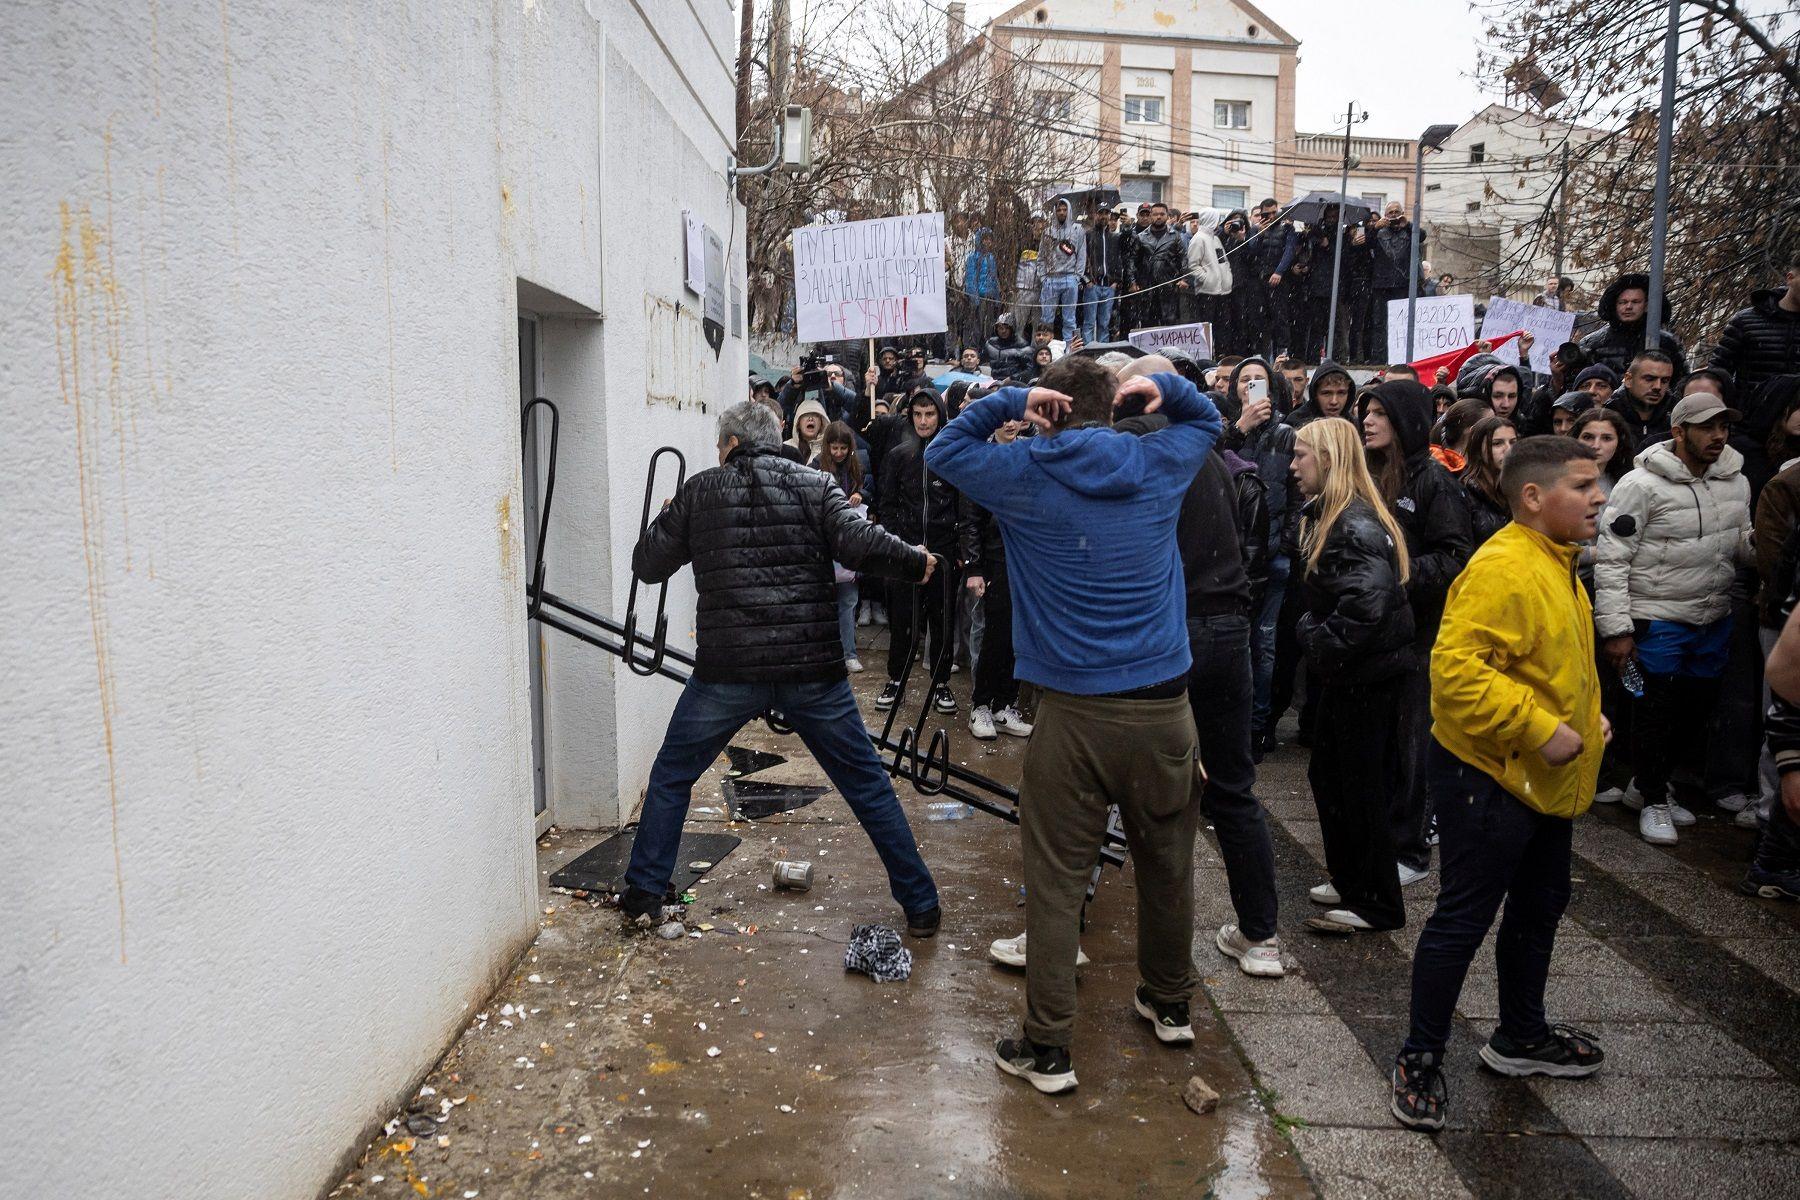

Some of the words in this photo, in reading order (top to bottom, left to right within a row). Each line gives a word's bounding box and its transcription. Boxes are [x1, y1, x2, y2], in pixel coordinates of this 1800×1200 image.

[863, 222, 887, 260] ШТО
[893, 216, 940, 257] ИМАА
[801, 265, 854, 305] ЗАДАЧА
[855, 263, 875, 301] ДА
[878, 259, 895, 298] НЕ
[896, 257, 939, 295] ЧУВААТ
[829, 300, 856, 340] НЕ
[1149, 328, 1201, 346] УМИРАМЕ
